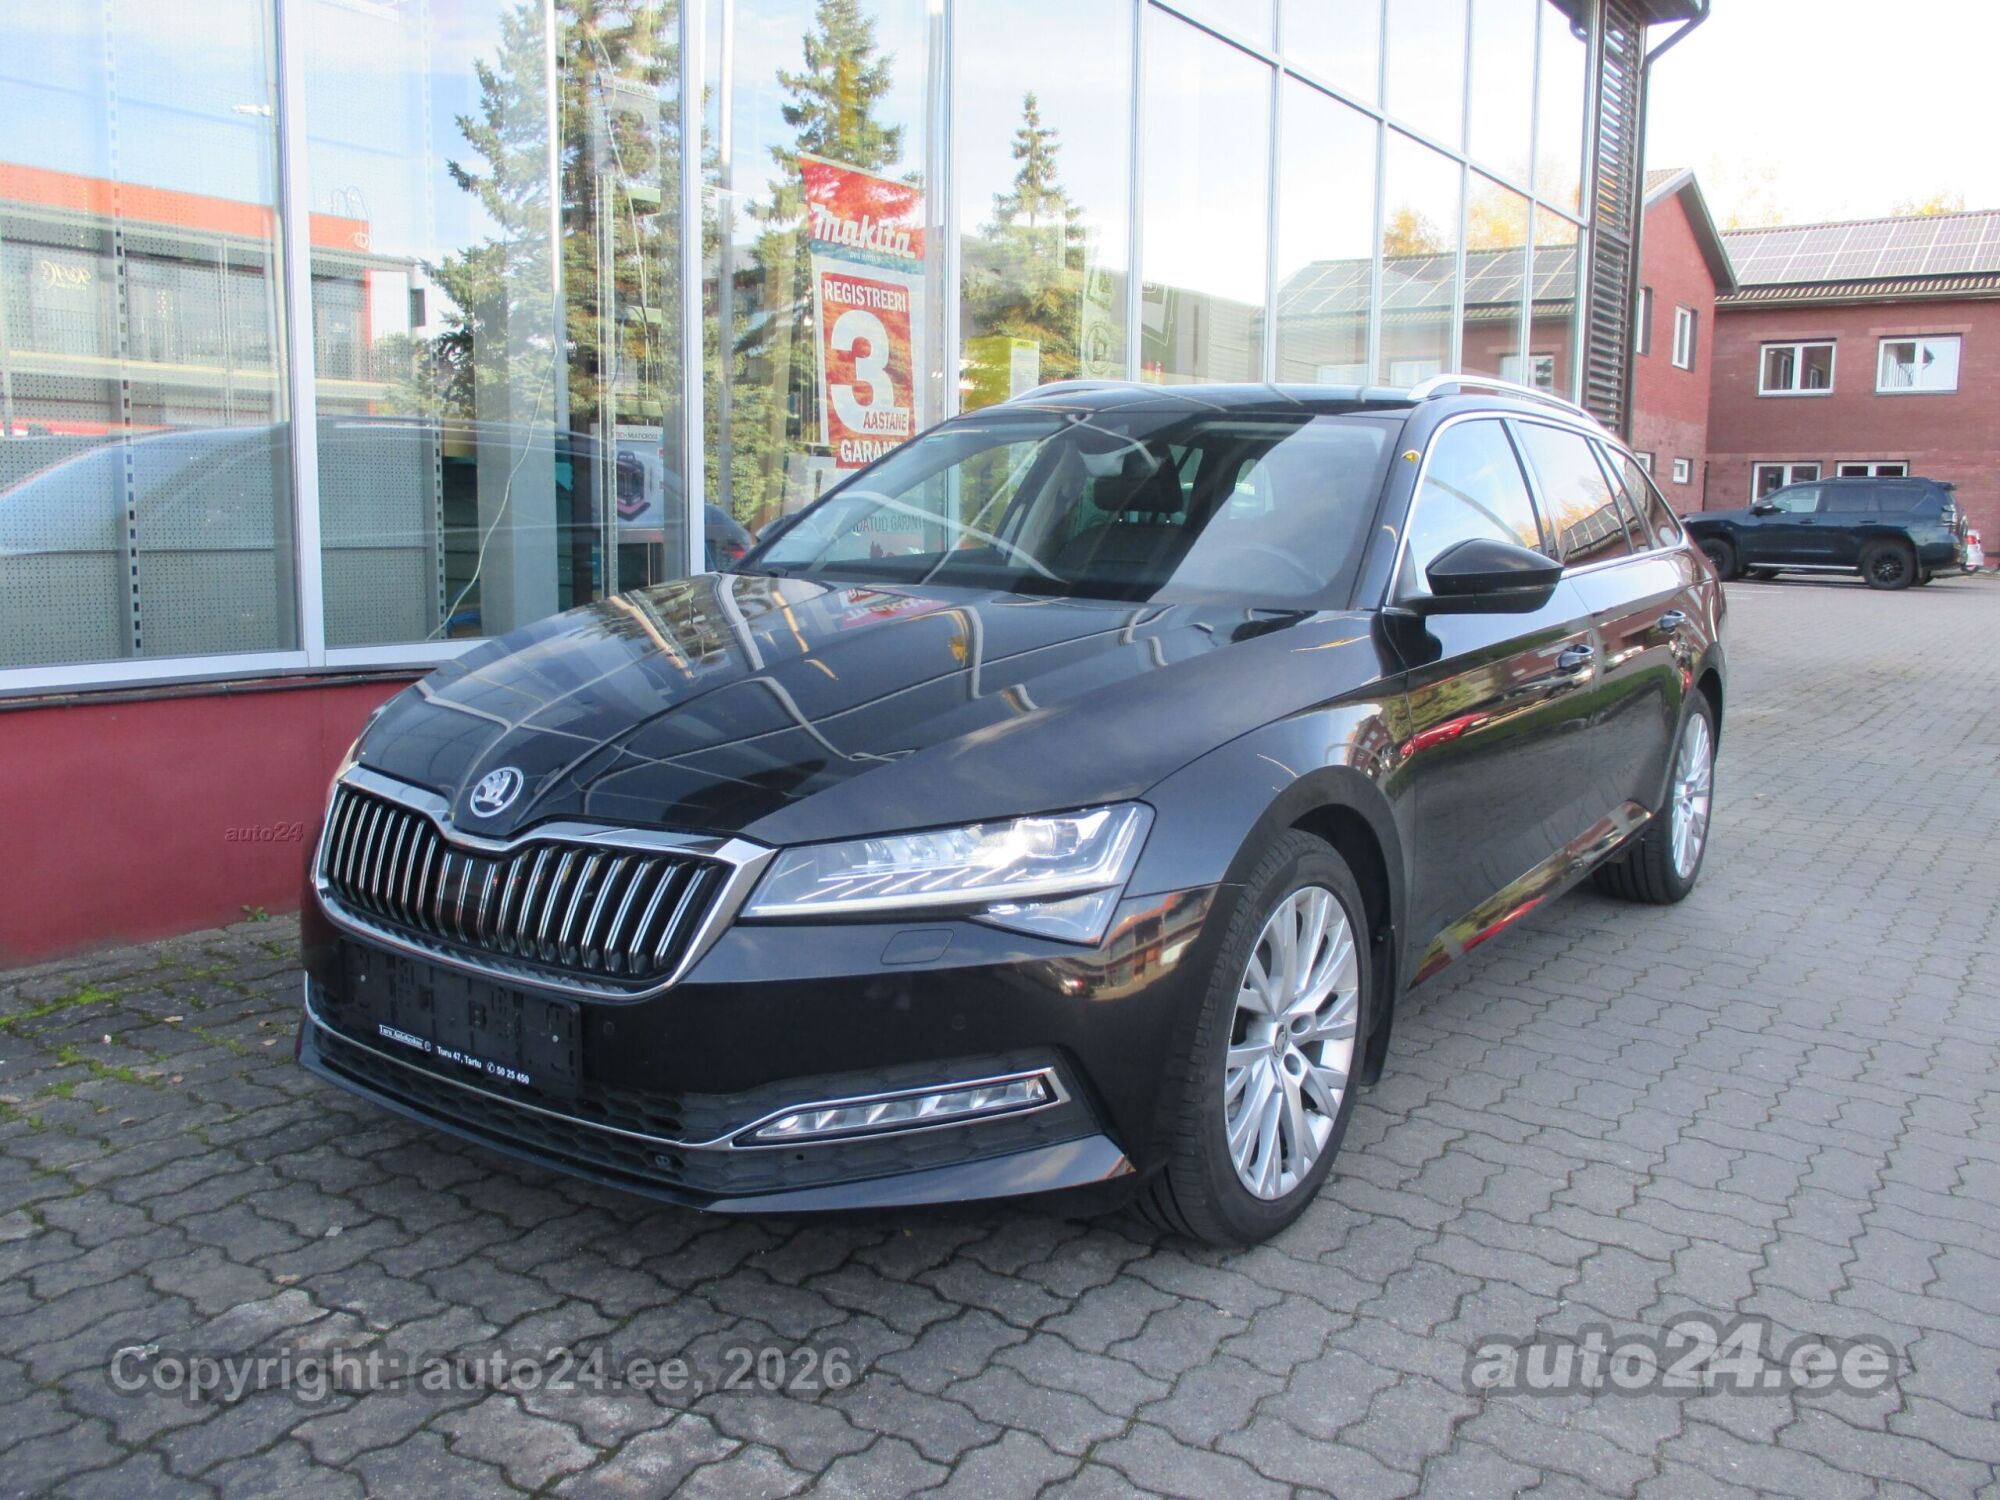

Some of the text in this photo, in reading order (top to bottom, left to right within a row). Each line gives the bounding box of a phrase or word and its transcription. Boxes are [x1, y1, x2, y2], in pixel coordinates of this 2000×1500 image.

[810, 201, 916, 259] makita
[822, 279, 907, 312] REGISTREERI
[830, 309, 911, 435] 3
[862, 409, 908, 432] AASTANE
[437, 1046, 452, 1058] Turu
[464, 1055, 482, 1069] Tartu
[506, 1069, 515, 1079] 25
